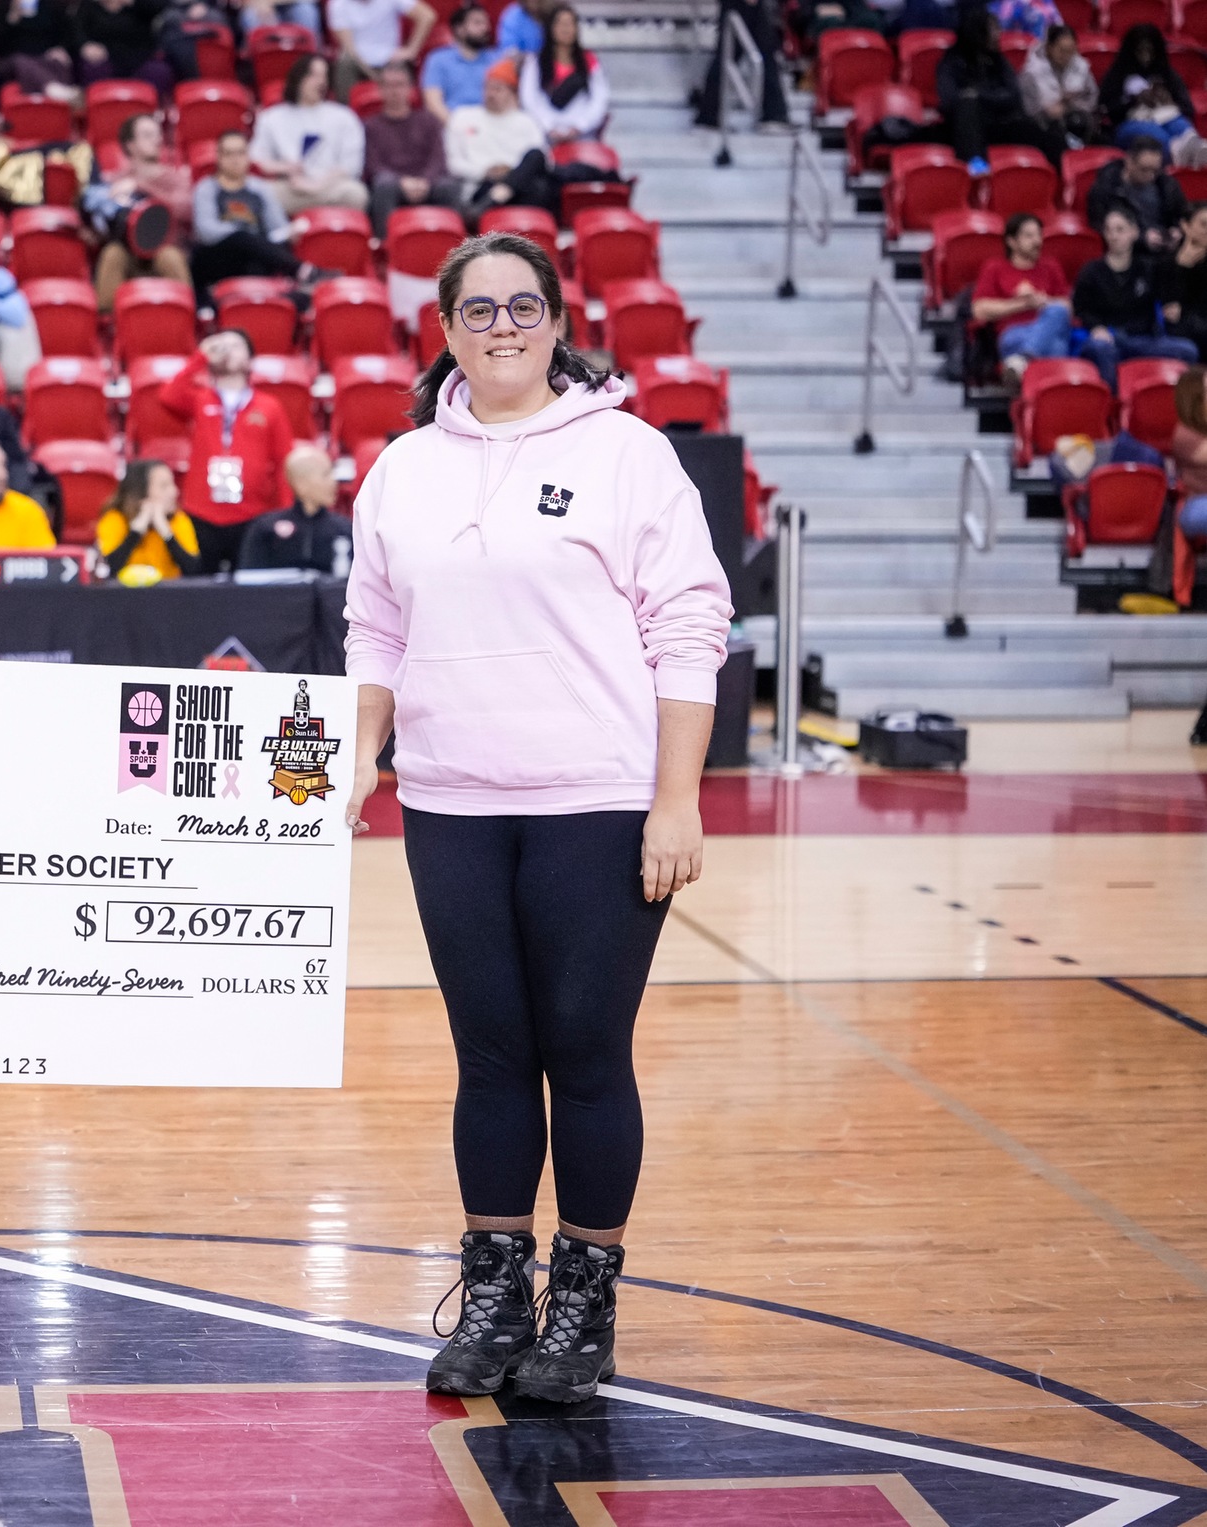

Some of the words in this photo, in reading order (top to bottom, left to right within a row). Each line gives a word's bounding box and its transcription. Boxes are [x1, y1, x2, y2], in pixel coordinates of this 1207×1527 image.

[539, 496, 570, 509] SPORTS
[176, 685, 233, 722] SHOOT
[174, 723, 206, 759] FOR
[213, 724, 244, 761] THE
[307, 730, 319, 738] Life
[265, 739, 279, 750] LE
[280, 740, 290, 750] 8
[291, 740, 337, 752] ULTIME
[129, 755, 158, 765] SPORTS
[275, 751, 314, 762] FINAL
[317, 752, 327, 763] 8
[173, 761, 217, 799] CURE
[106, 819, 151, 834] Date:
[178, 815, 248, 836] March
[256, 819, 270, 841] 8,
[278, 818, 323, 837] 2026
[47, 855, 173, 879] SOCIETY
[74, 903, 96, 941] $
[134, 906, 306, 941] 92,697.67
[306, 959, 326, 973] 67
[37, 968, 184, 994] Ninety-Seven
[203, 978, 295, 994] DOLLARS
[303, 980, 327, 994] XX
